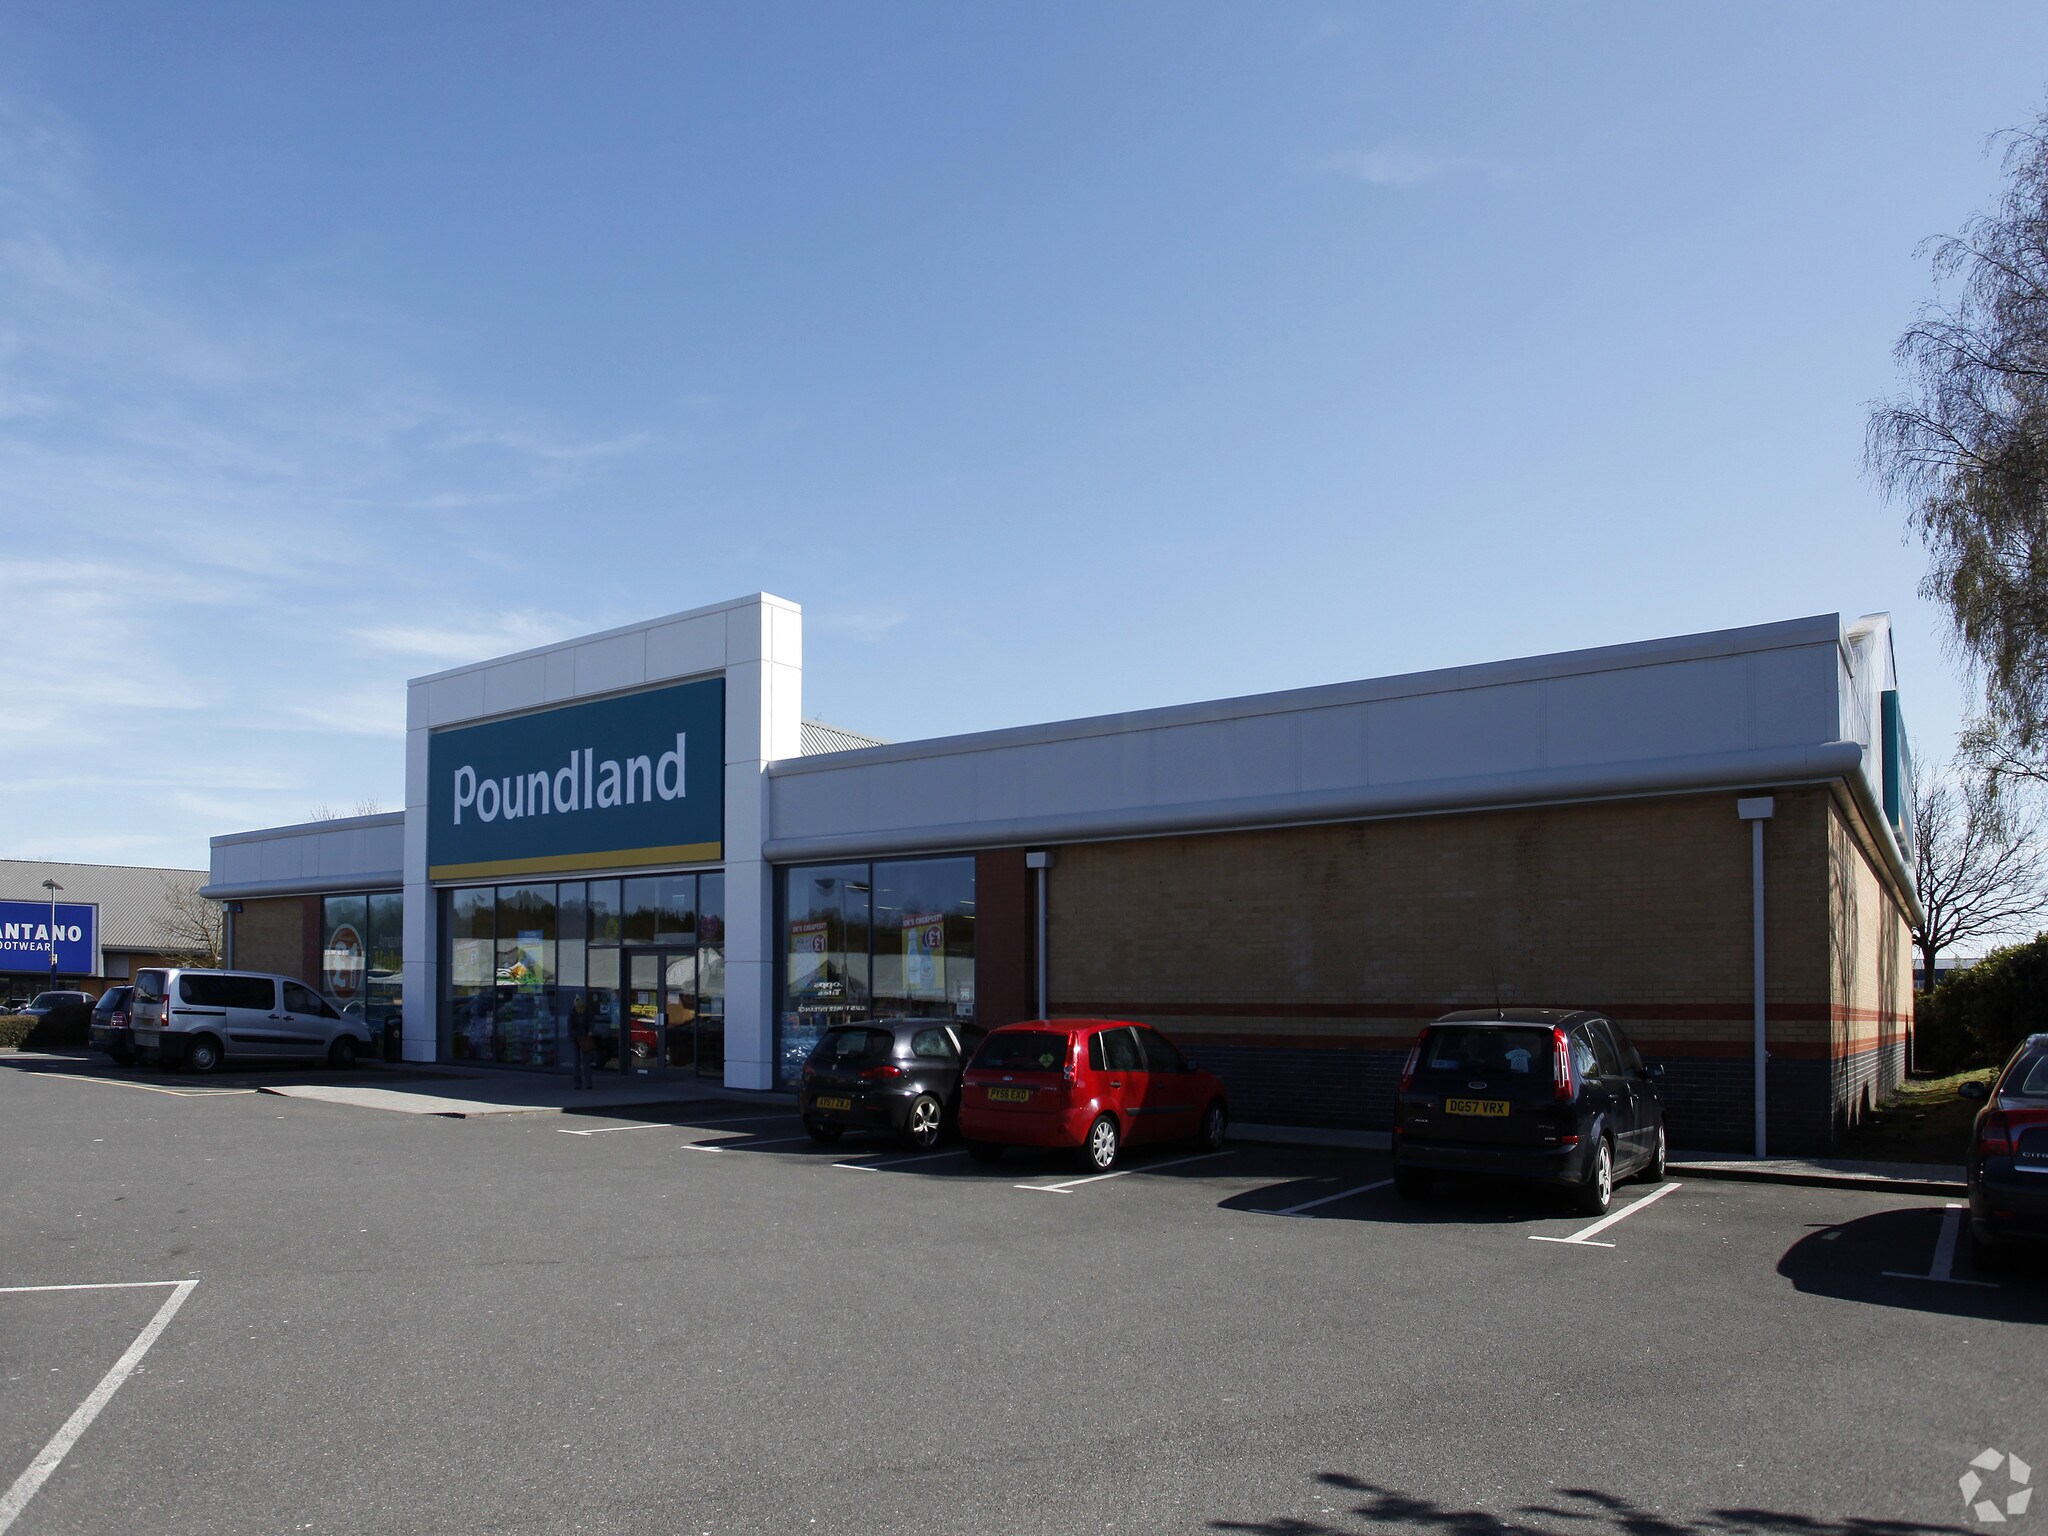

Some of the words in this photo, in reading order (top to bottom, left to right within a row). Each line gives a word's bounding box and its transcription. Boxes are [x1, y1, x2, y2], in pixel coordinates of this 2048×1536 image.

[453, 732, 686, 825] Poundland
[0, 923, 82, 942] NTANO
[928, 929, 941, 945] £1
[814, 938, 825, 951] £1
[1450, 1101, 1479, 1113] DG57
[1483, 1103, 1504, 1115] VRX
